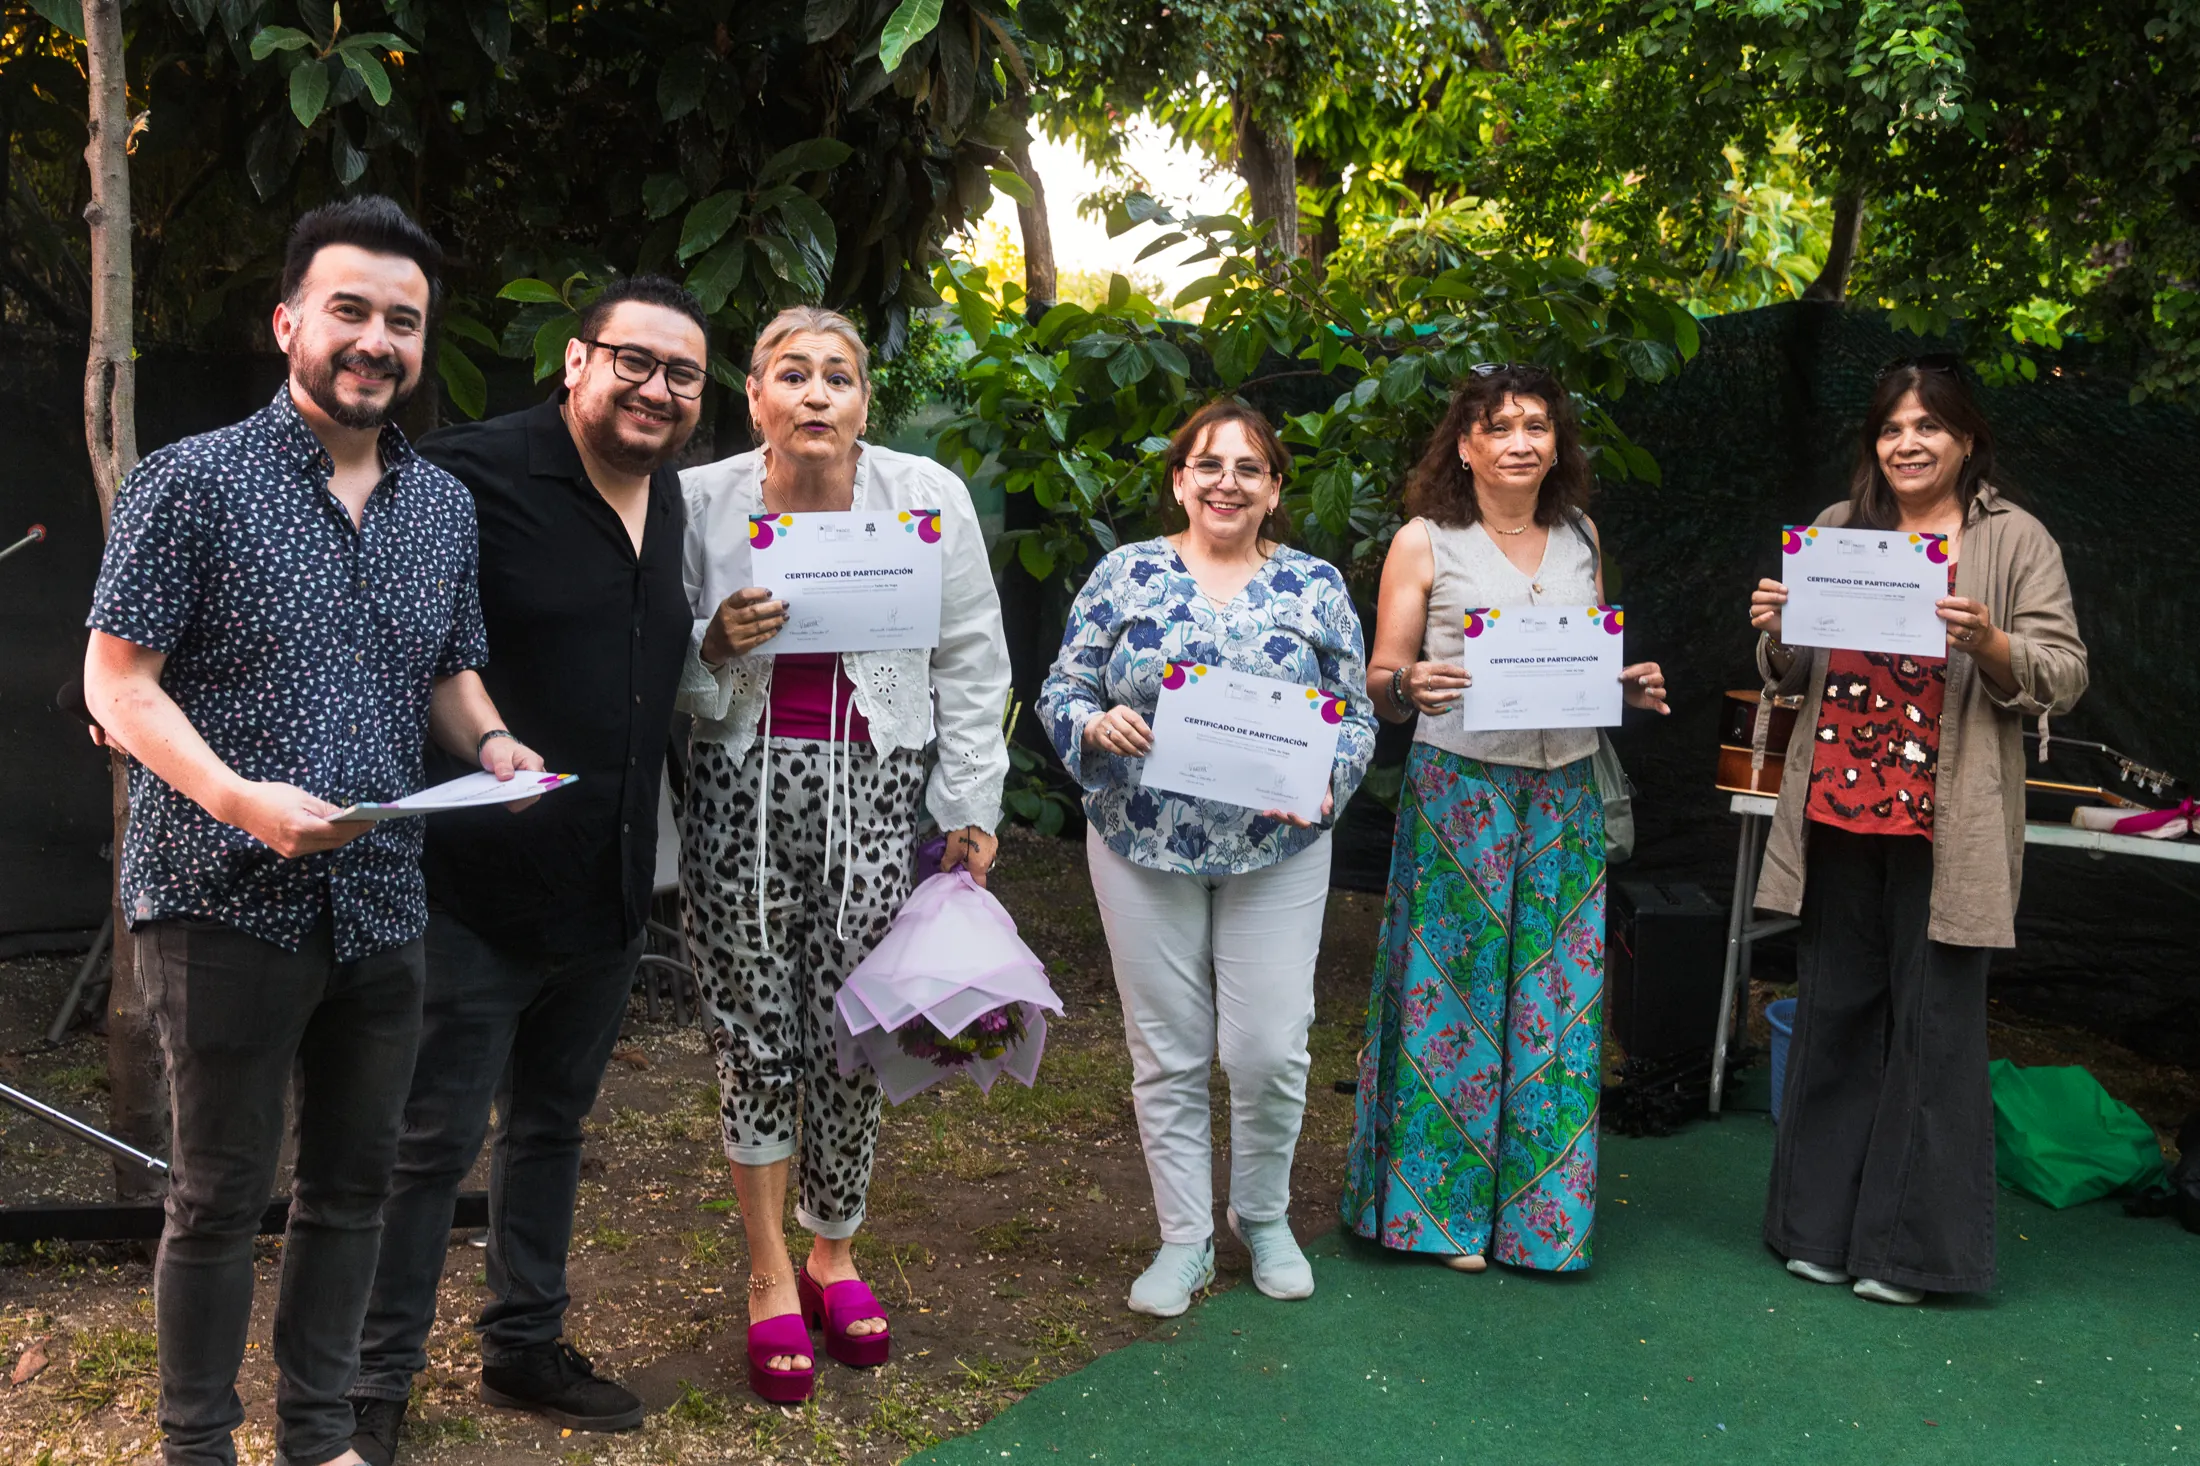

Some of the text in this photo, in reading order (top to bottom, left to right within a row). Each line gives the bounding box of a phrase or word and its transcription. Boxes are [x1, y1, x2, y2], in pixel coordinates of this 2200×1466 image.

[785, 571, 838, 580] CERTIFICADO
[854, 568, 913, 577] PARTICIPACIÓN
[1807, 576, 1852, 585] CERTIFICADO
[1865, 580, 1920, 589] PARTICIPACIÓN
[1184, 716, 1235, 733] CERTIFICADO
[1249, 730, 1308, 748] PARTICIPACIÓN
